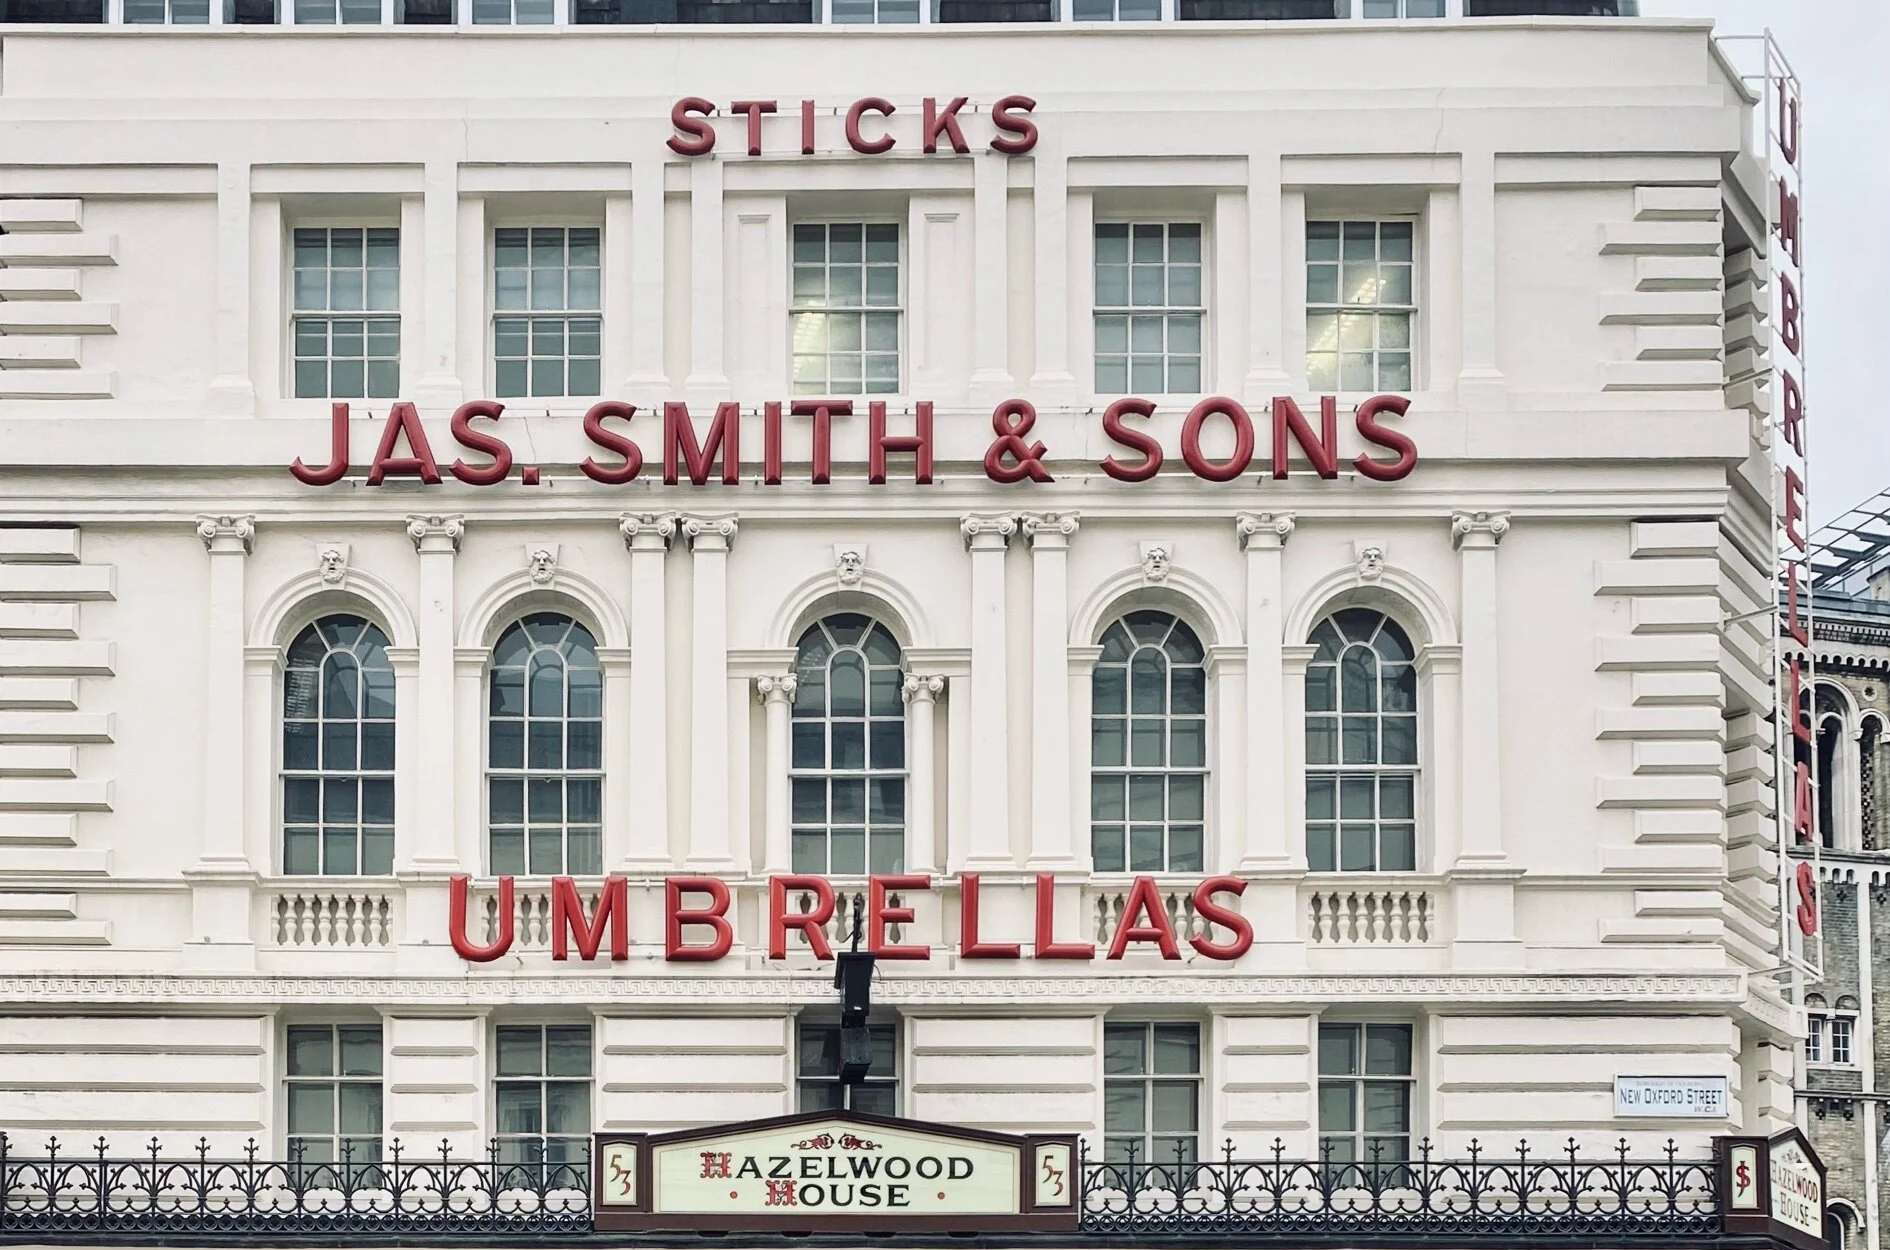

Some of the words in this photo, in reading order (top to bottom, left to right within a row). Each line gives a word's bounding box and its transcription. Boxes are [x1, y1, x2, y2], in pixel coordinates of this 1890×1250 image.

[666, 95, 1039, 156] STICKS
[289, 400, 541, 487] JAS.
[579, 400, 934, 486] SMITH
[984, 398, 1056, 485] &
[1100, 395, 1418, 483] SONS
[1779, 75, 1816, 937] UMBRELLAS
[448, 873, 1254, 963] UMBRELLAS
[1620, 1088, 1641, 1104] NEW
[1645, 1088, 1683, 1104] OXFORD
[1687, 1088, 1723, 1105] STREET
[610, 1153, 632, 1195] 53
[700, 1151, 974, 1179] HAZELWOOD
[1041, 1154, 1064, 1196] 53
[1770, 1158, 1819, 1204] HAZELWOOD
[764, 1180, 911, 1206] HOUSE
[1779, 1191, 1810, 1227] HOUSE
